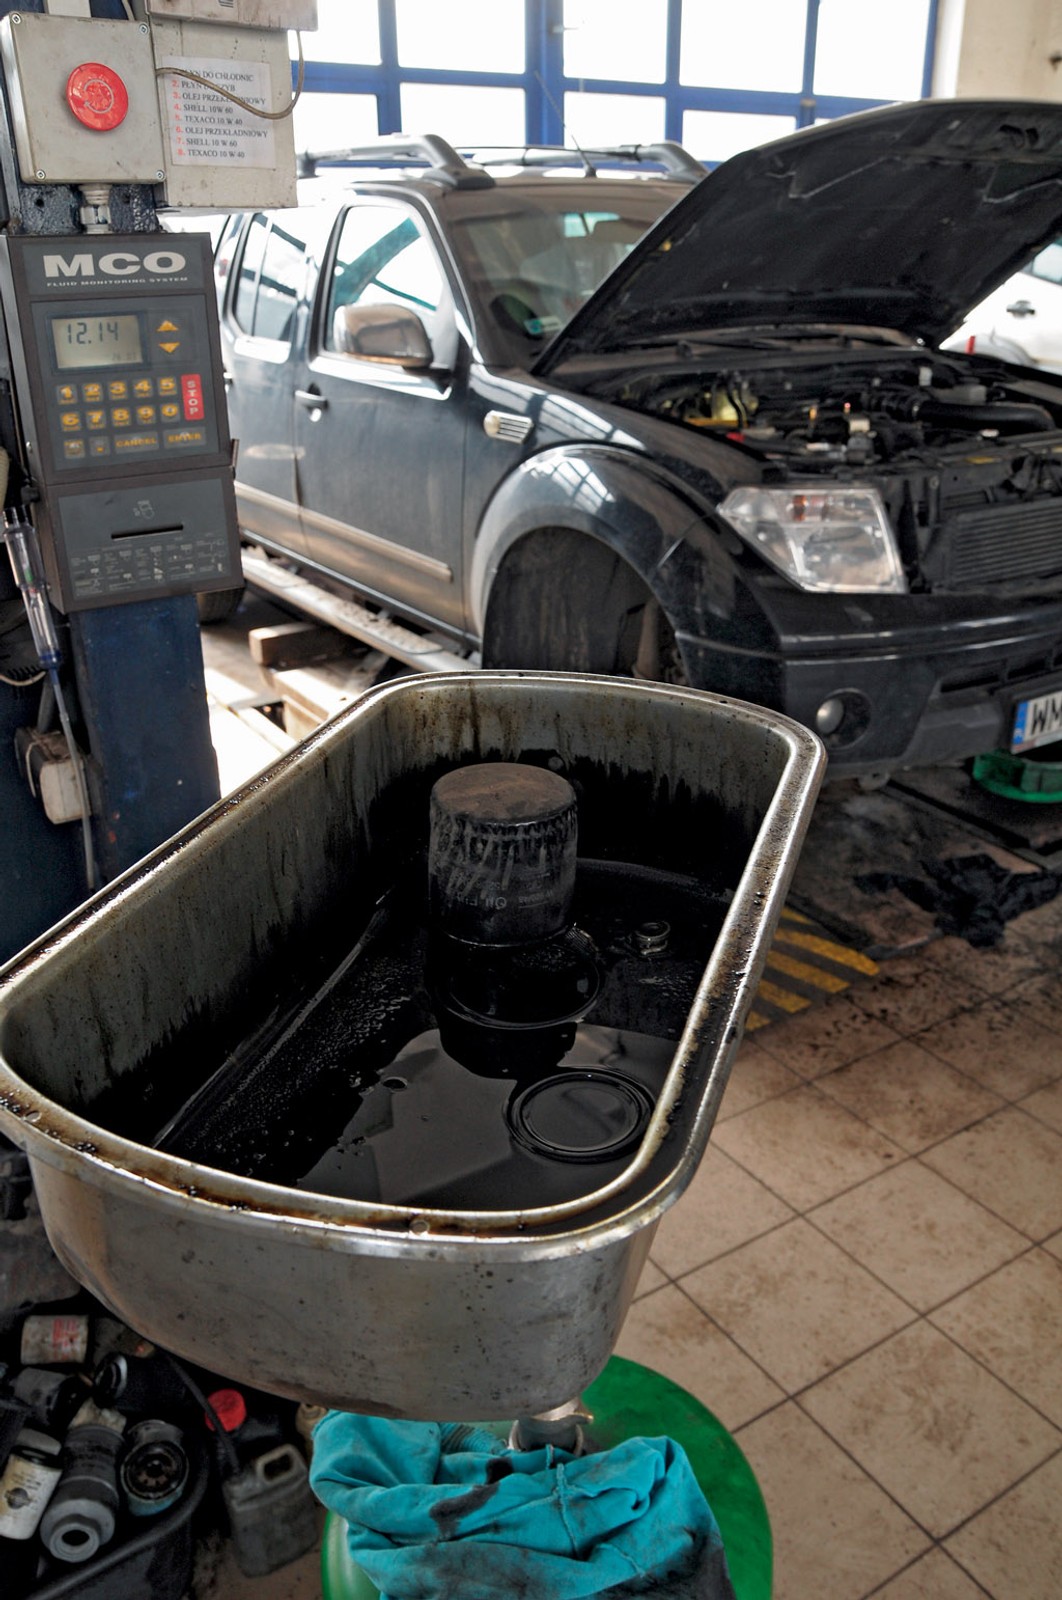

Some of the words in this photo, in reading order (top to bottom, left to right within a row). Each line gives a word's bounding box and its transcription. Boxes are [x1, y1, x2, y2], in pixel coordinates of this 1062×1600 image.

[182, 93, 201, 101] OLEJ
[183, 104, 207, 113] SHELL
[185, 115, 216, 124] TEXACO
[185, 126, 204, 135] OLEJ
[186, 138, 209, 146] SHELL
[187, 149, 218, 158] TEXACO
[43, 251, 186, 278] MCO
[80, 278, 146, 287] MONITORING
[67, 321, 119, 345] 12.14
[60, 386, 73, 399] 1
[85, 383, 100, 397] 2
[109, 381, 126, 395] 3
[134, 379, 151, 391] 4
[159, 377, 175, 390] 5
[186, 379, 199, 415] STOP
[62, 413, 80, 426] 6
[87, 410, 103, 423] 7
[112, 407, 130, 421] 8
[137, 405, 155, 420] 9
[161, 403, 178, 417] 0
[116, 437, 157, 448] CANCEL
[168, 432, 201, 443] ENTER
[1030, 697, 1062, 736] WM
